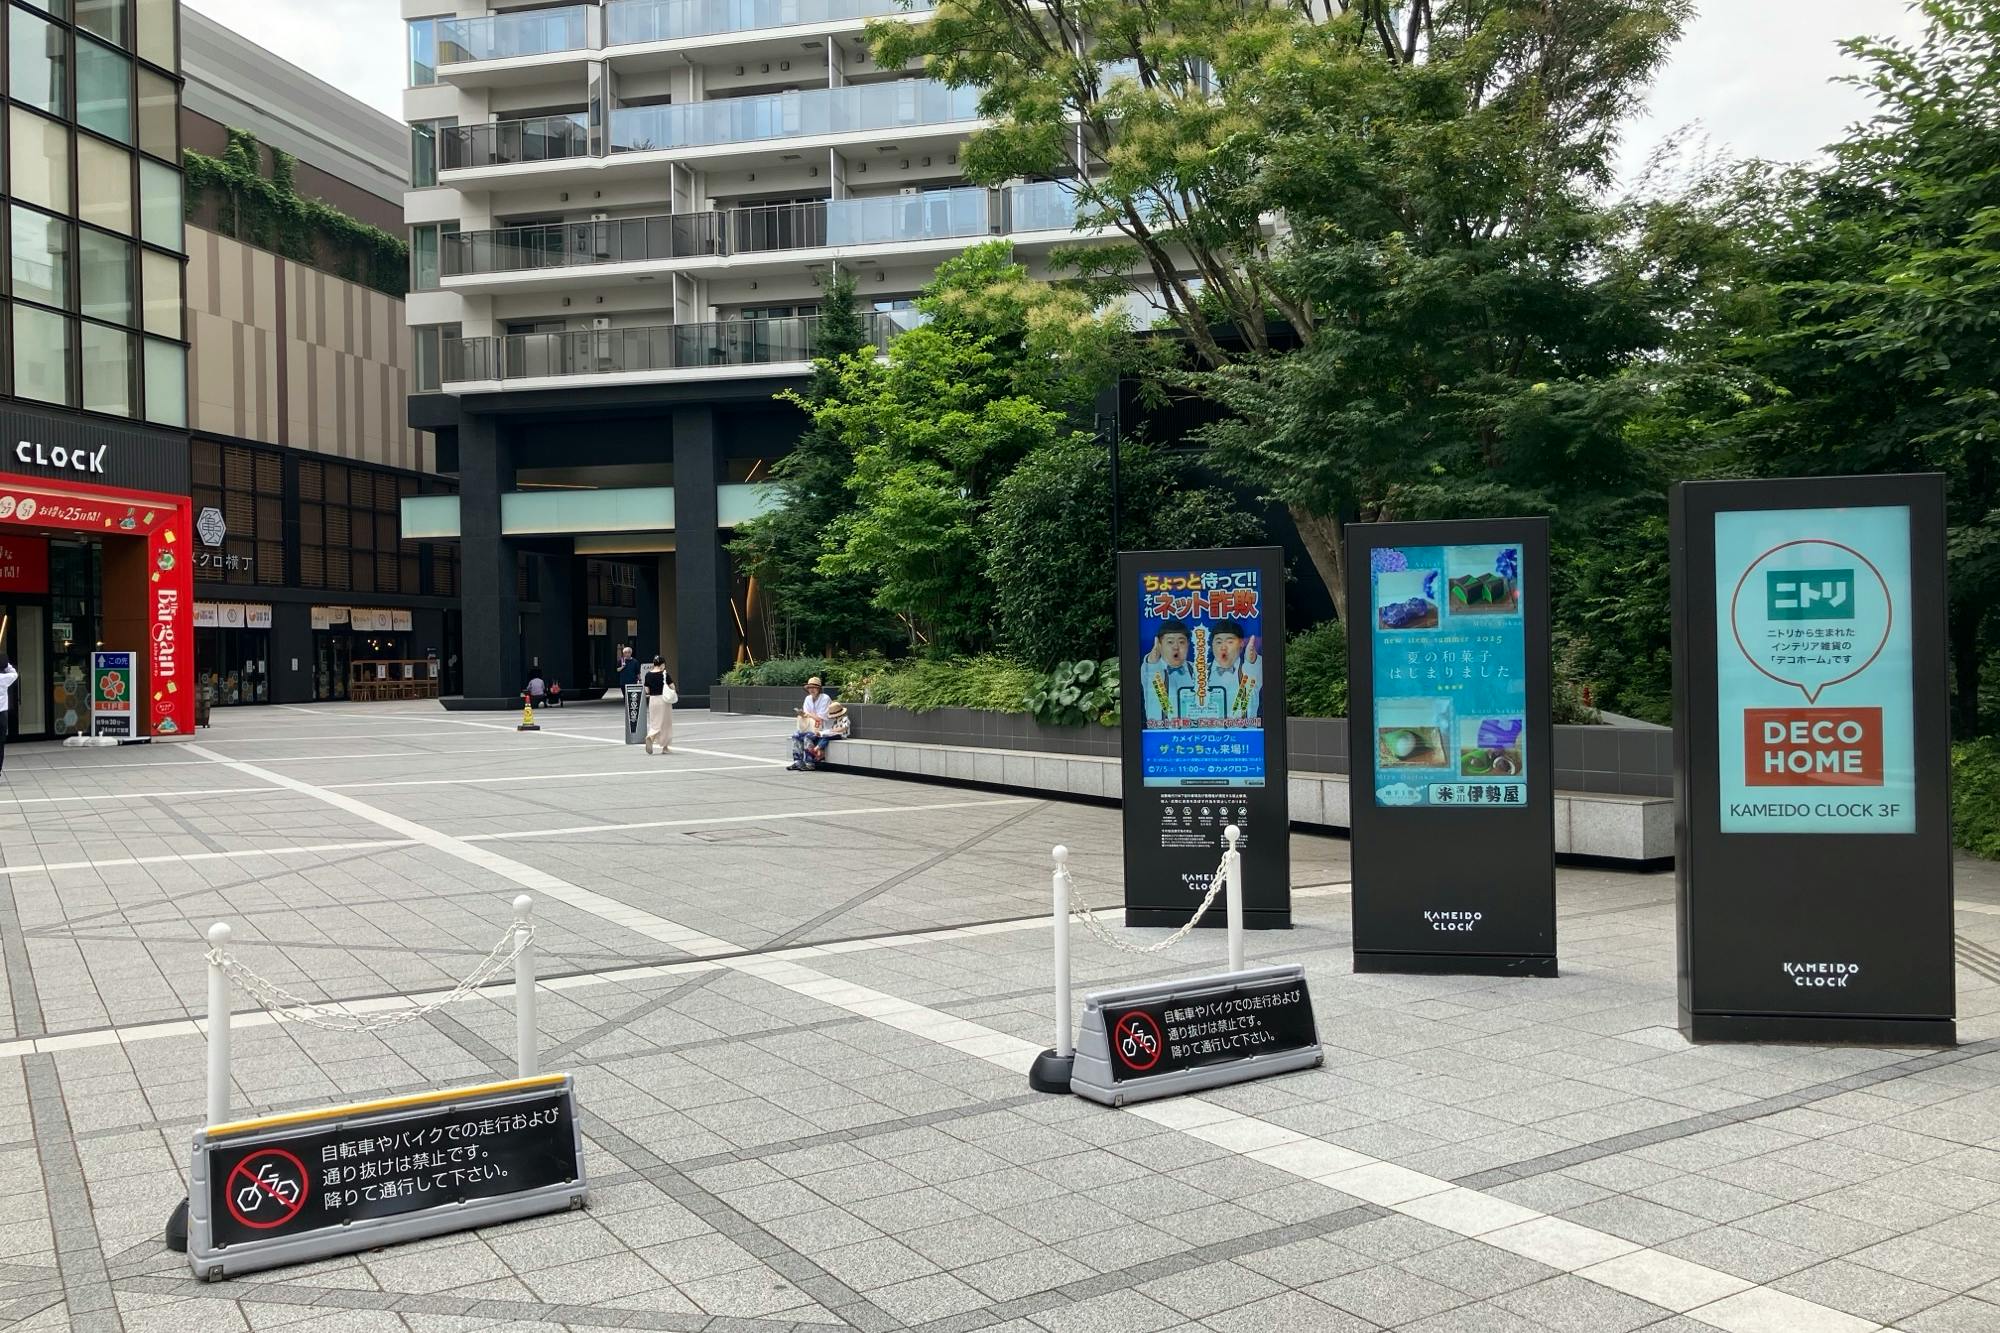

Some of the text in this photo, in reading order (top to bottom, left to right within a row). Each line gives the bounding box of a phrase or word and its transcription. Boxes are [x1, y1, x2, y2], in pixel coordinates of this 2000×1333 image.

[15, 440, 107, 474] CLOCK
[1144, 571, 1257, 591] ちょっと待って!!
[1153, 589, 1260, 619] ネット詐欺
[1774, 581, 1847, 609] ニトリ
[152, 589, 177, 677] Bargain
[1767, 627, 1856, 639] ニトリから生まれた
[1771, 641, 1852, 651] インテリア雑貨の
[108, 657, 129, 665] この先
[1407, 650, 1492, 664] 夏の和菓子
[1771, 654, 1852, 665] 「デコホーム」です
[1390, 666, 1510, 680] はじまりました
[1171, 734, 1236, 743] カメイドクロックに
[1763, 720, 1863, 744] DECO
[1764, 750, 1863, 773] HOME
[1467, 784, 1520, 804] 伊勢屋
[1730, 803, 1901, 817] KAMEIDO CLOCK 3F
[1423, 910, 1483, 923] KAMEIDO
[1432, 920, 1475, 932] CLOCK
[1783, 962, 1860, 977] KAMEIDO
[1794, 974, 1849, 988] CLOCK
[1164, 989, 1301, 1025] 自転車やバイクでの走行および
[1168, 1015, 1262, 1042] 通り抜けは禁止です。
[1171, 1031, 1276, 1060] 降りて通行して下さい。
[321, 1106, 560, 1162] 自転車やバイクでの走行および
[322, 1147, 490, 1187] 通り抜けは禁止です。
[324, 1167, 510, 1211] 降りて通行して下さい。
